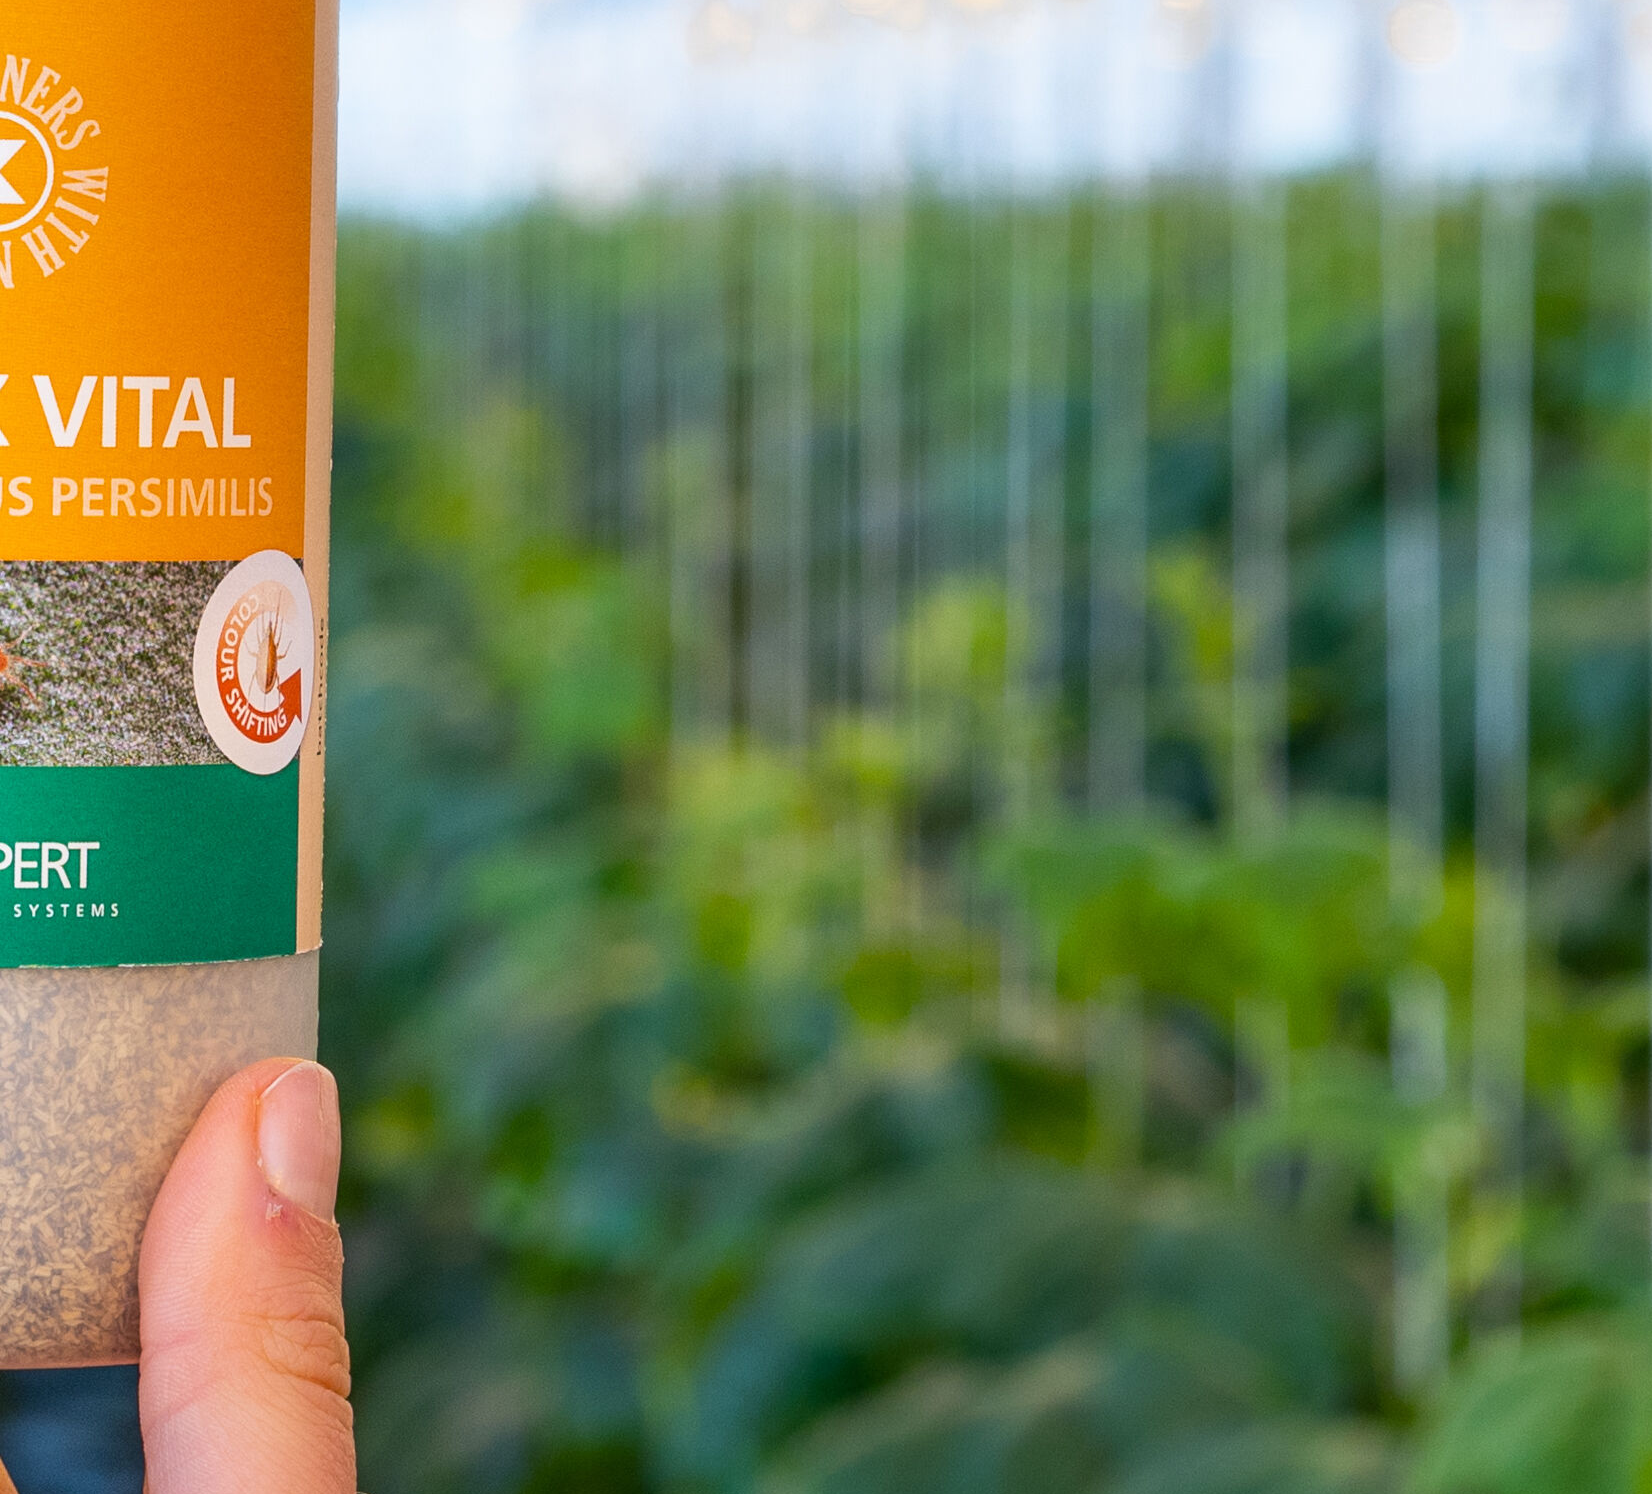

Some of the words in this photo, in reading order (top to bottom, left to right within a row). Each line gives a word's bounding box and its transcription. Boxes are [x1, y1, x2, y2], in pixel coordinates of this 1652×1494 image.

[20, 165, 109, 278] WITH
[32, 374, 252, 449] VITAL
[51, 475, 273, 518] PERSIMILIS
[219, 593, 261, 684] COLOUR
[225, 687, 288, 737] SHIFTING
[13, 902, 119, 918] SYSTEMS
